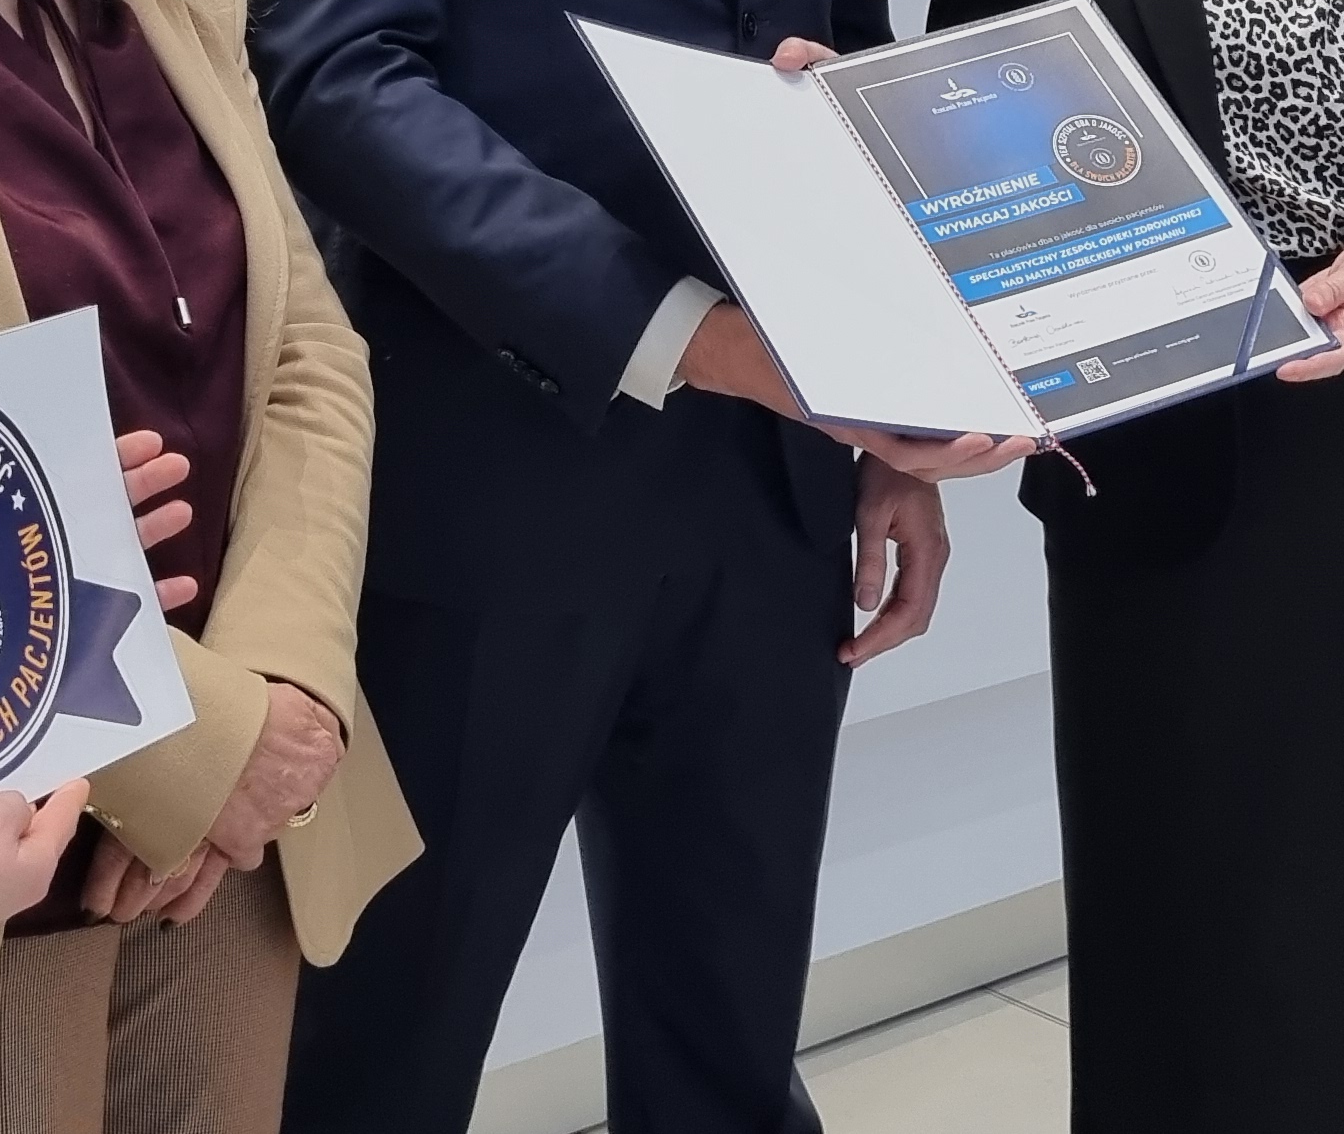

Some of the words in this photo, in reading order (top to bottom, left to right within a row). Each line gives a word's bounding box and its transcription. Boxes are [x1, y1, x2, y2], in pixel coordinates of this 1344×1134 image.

[920, 172, 1041, 215] WYRÓŻNIENIE
[934, 207, 1010, 237] WYMAGAJ
[1011, 189, 1073, 216] JAKOŚCI
[969, 252, 1058, 285] SPECJALISTYCZNY
[1059, 240, 1099, 259] ZESPÓŁ
[1098, 229, 1132, 247] OPIEKI
[1134, 207, 1202, 236] ZDROWOTNEJ
[988, 251, 1000, 260] Ta
[1001, 241, 1037, 258] placówka
[1038, 235, 1054, 246] dba
[1060, 226, 1085, 242] jakość
[1085, 221, 1098, 231] dla
[1098, 215, 1126, 229] swoich
[1125, 203, 1165, 222] pacjentów
[1001, 276, 1024, 289] NAD
[1025, 265, 1062, 283] MATKĄ
[1067, 246, 1122, 270] DZIECKIEM
[1121, 243, 1134, 253] W
[1134, 226, 1186, 250] POZNANIU
[15, 521, 55, 710] PACJENTÓW
